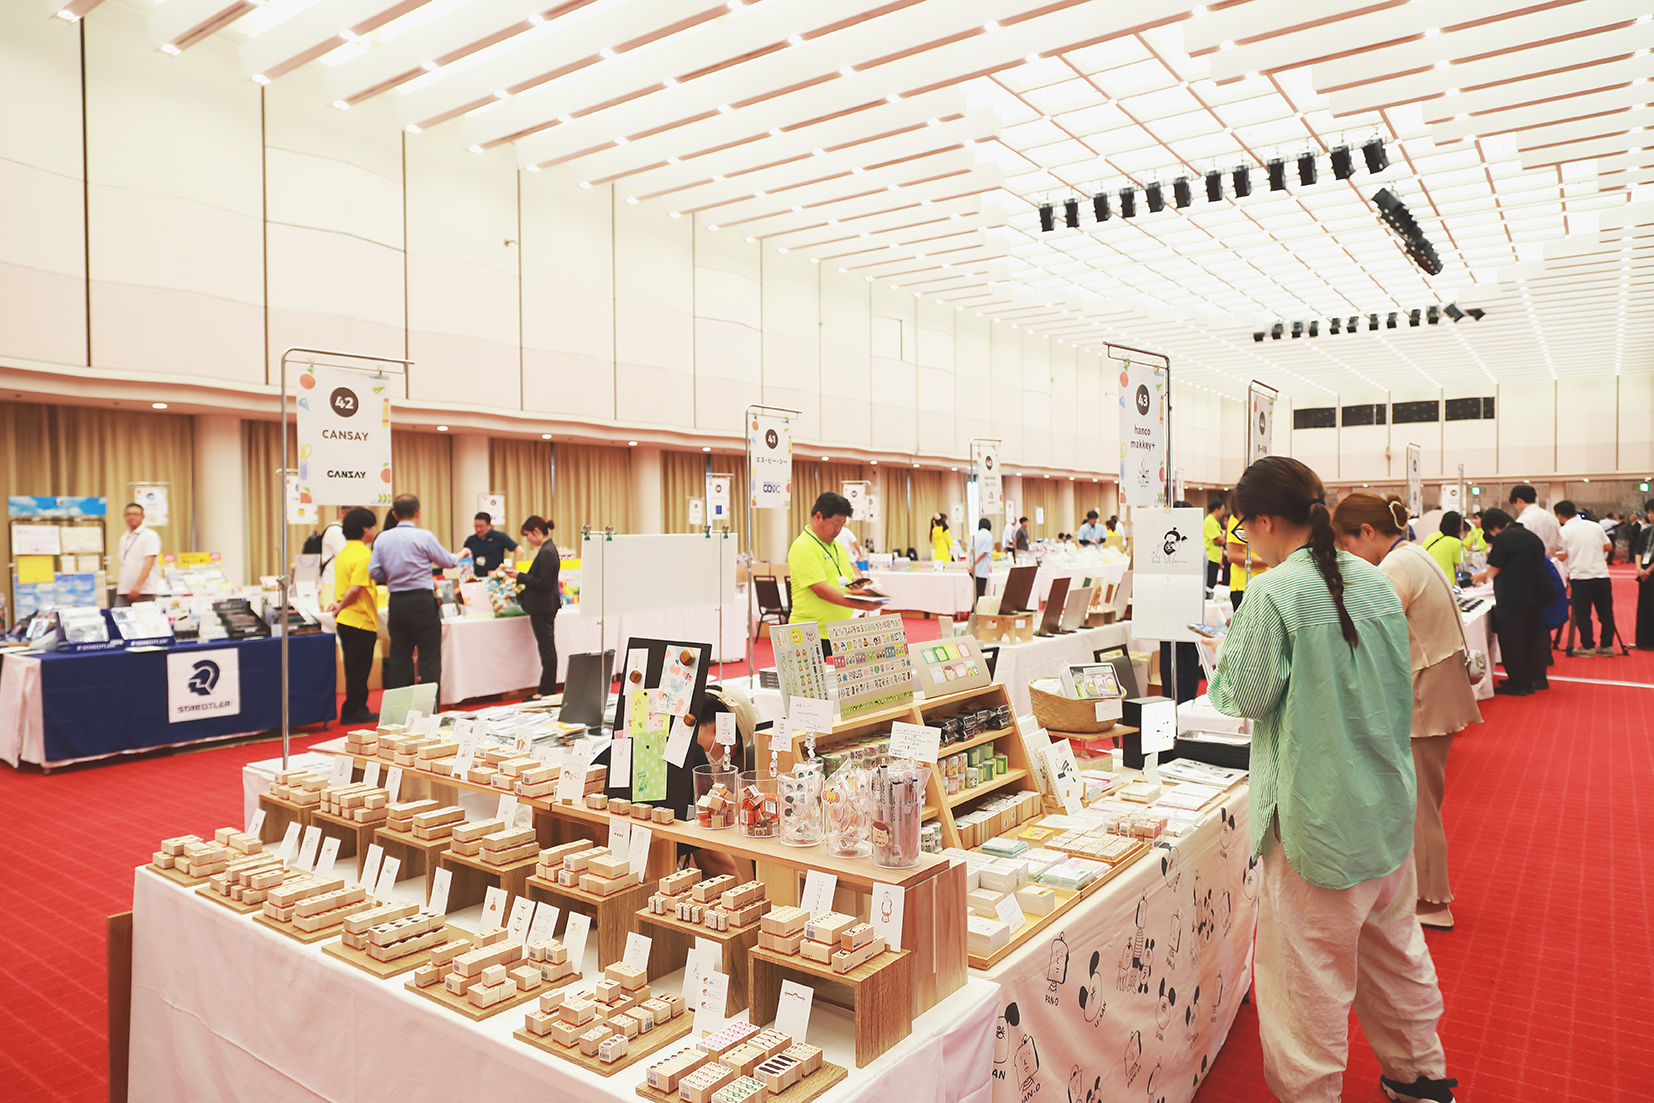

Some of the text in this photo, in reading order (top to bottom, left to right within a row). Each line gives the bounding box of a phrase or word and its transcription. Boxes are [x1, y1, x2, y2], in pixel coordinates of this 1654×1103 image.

[334, 396, 354, 409] 42
[1138, 393, 1149, 407] 43
[322, 429, 369, 441] CANSAY
[1134, 424, 1151, 436] hanco
[767, 434, 776, 444] 41
[1130, 439, 1155, 452] makkey+
